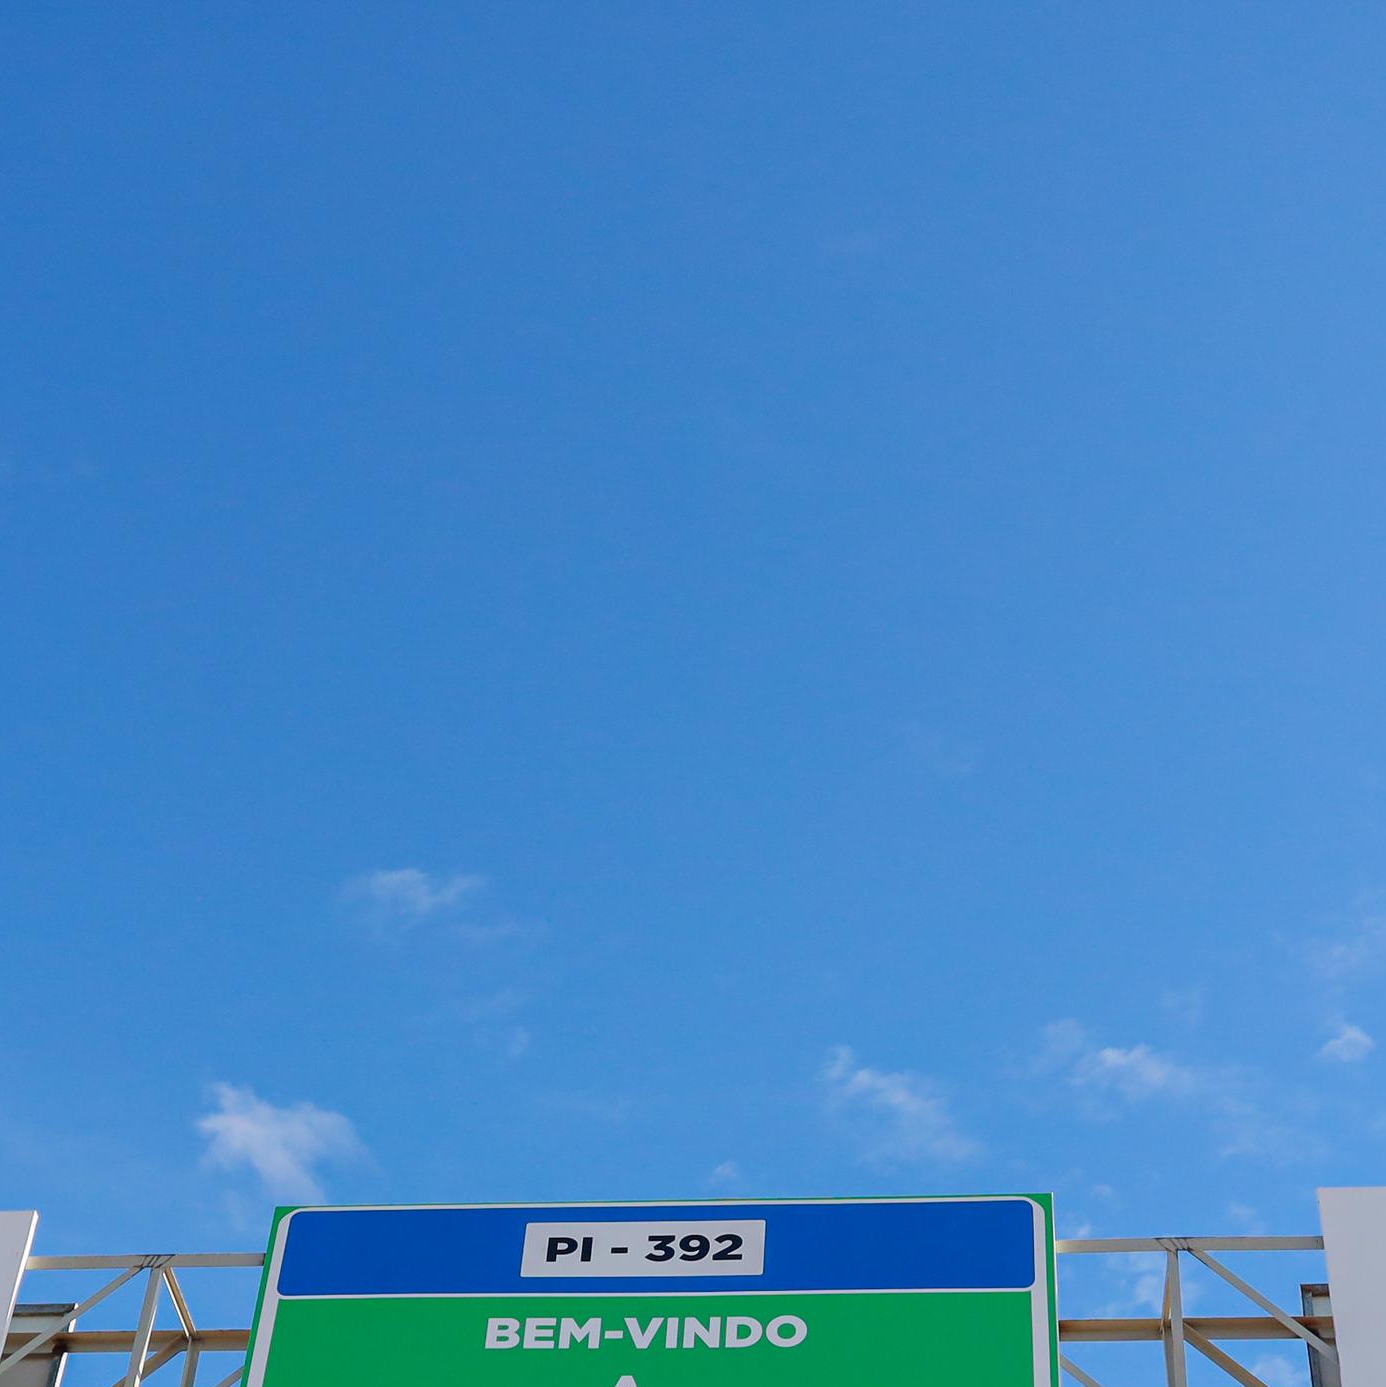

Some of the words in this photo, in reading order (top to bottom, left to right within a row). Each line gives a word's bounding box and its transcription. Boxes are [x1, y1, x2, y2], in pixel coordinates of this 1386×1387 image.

[546, 1237, 593, 1262] PI
[645, 1234, 743, 1262] 392
[485, 1315, 807, 1348] BEM-VINDO
